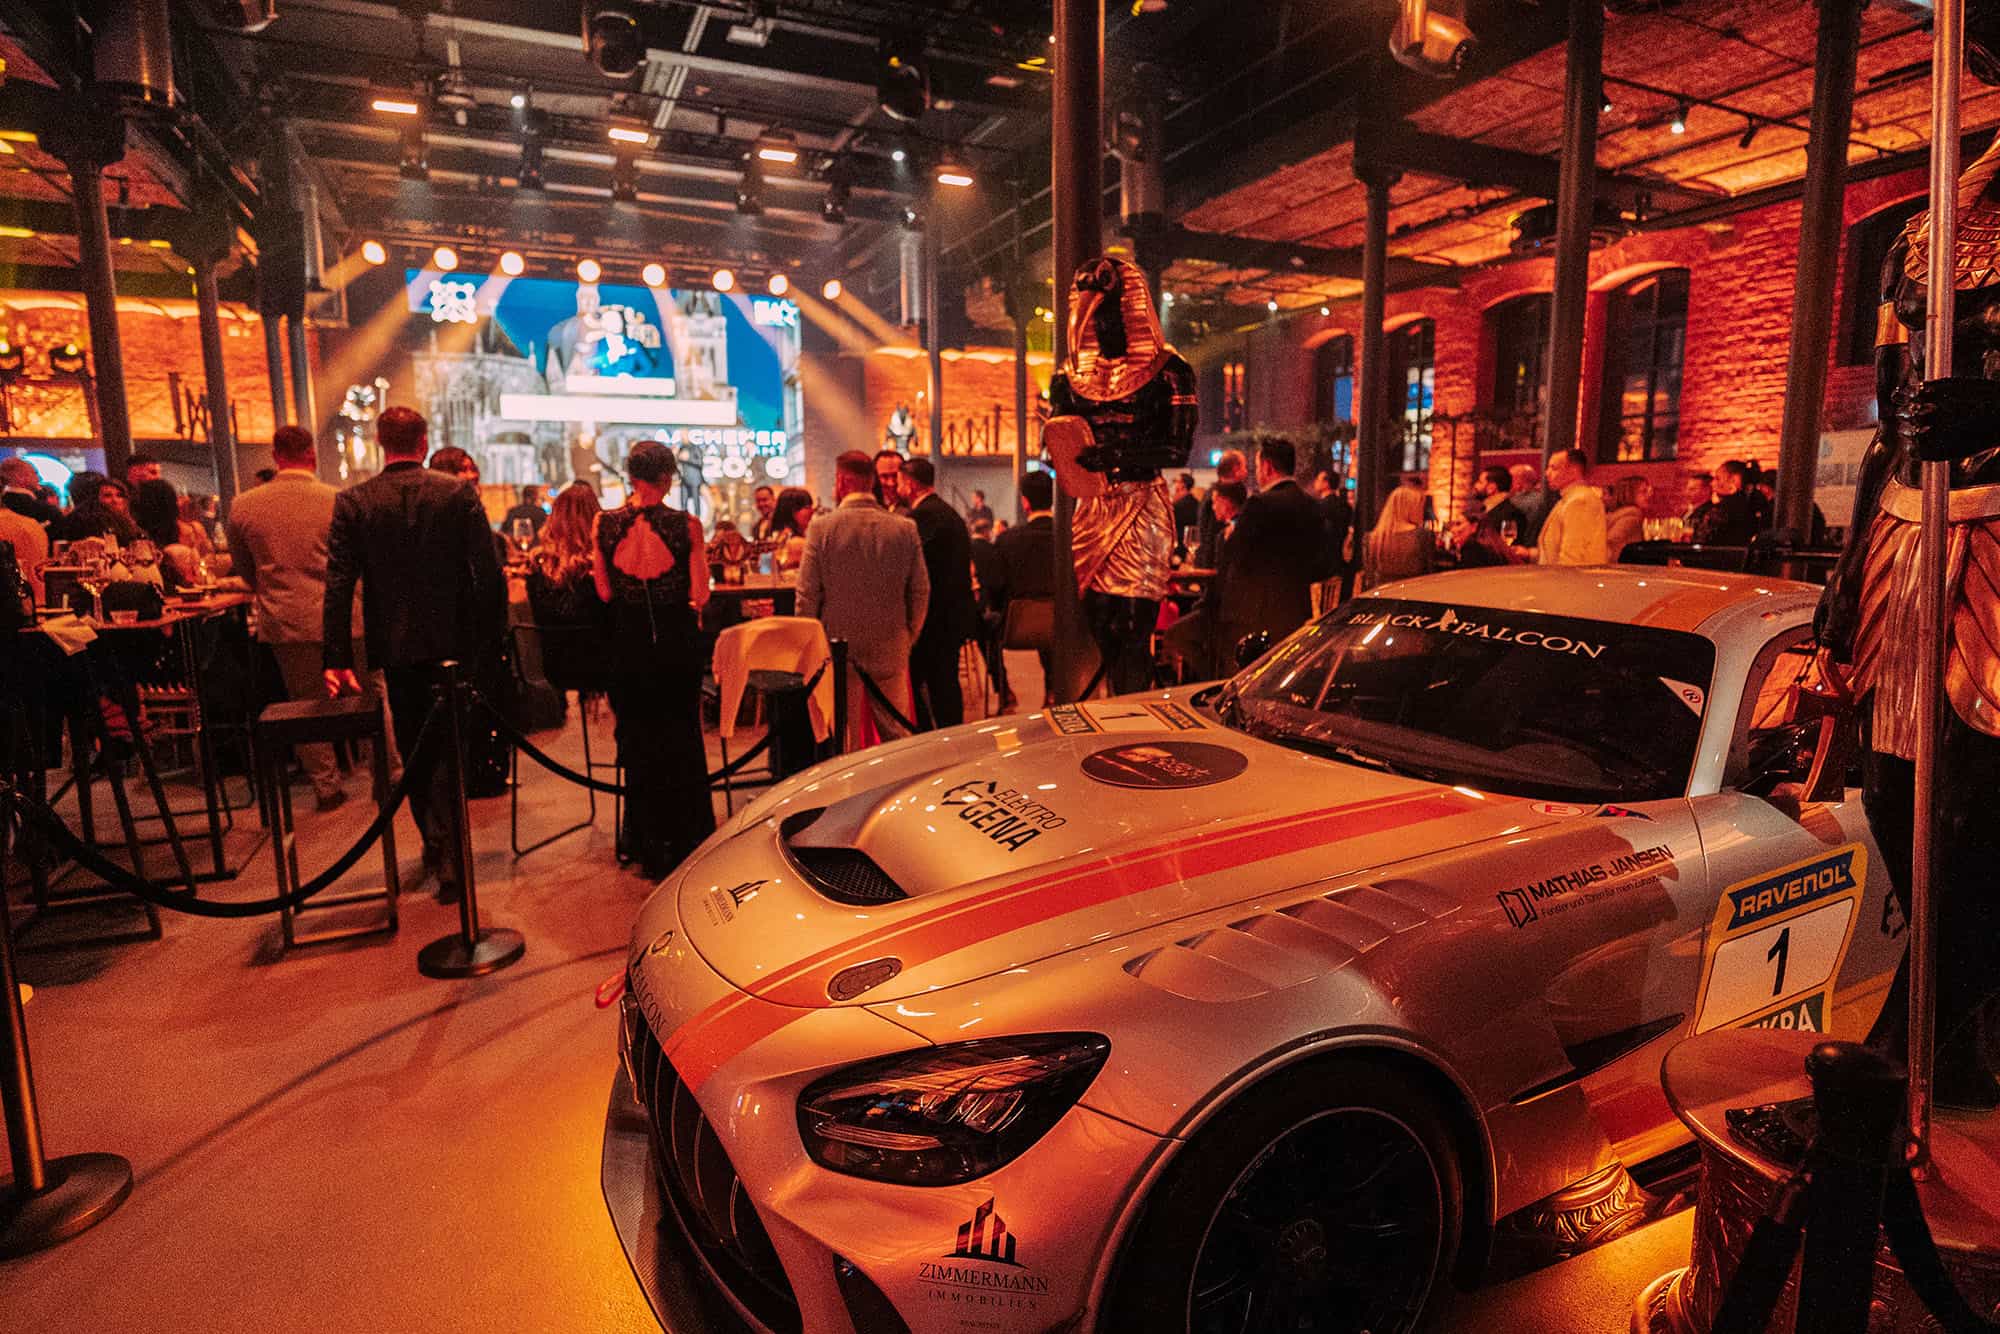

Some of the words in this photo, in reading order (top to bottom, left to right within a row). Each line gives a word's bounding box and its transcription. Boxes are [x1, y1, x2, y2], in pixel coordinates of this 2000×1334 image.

[1349, 613, 1431, 630] BLACK
[1450, 620, 1607, 659] FALCON
[958, 800, 1041, 852] GENA
[993, 788, 1067, 830] ELEKTRO
[1528, 864, 1608, 901] MATHIAS
[1609, 844, 1675, 877] JANSEN
[1739, 864, 1848, 918] RAVENOL
[1767, 926, 1790, 997] 1
[919, 1262, 1049, 1291] ZIMMERMANN
[928, 1290, 1036, 1309] IMMOBILIEN
